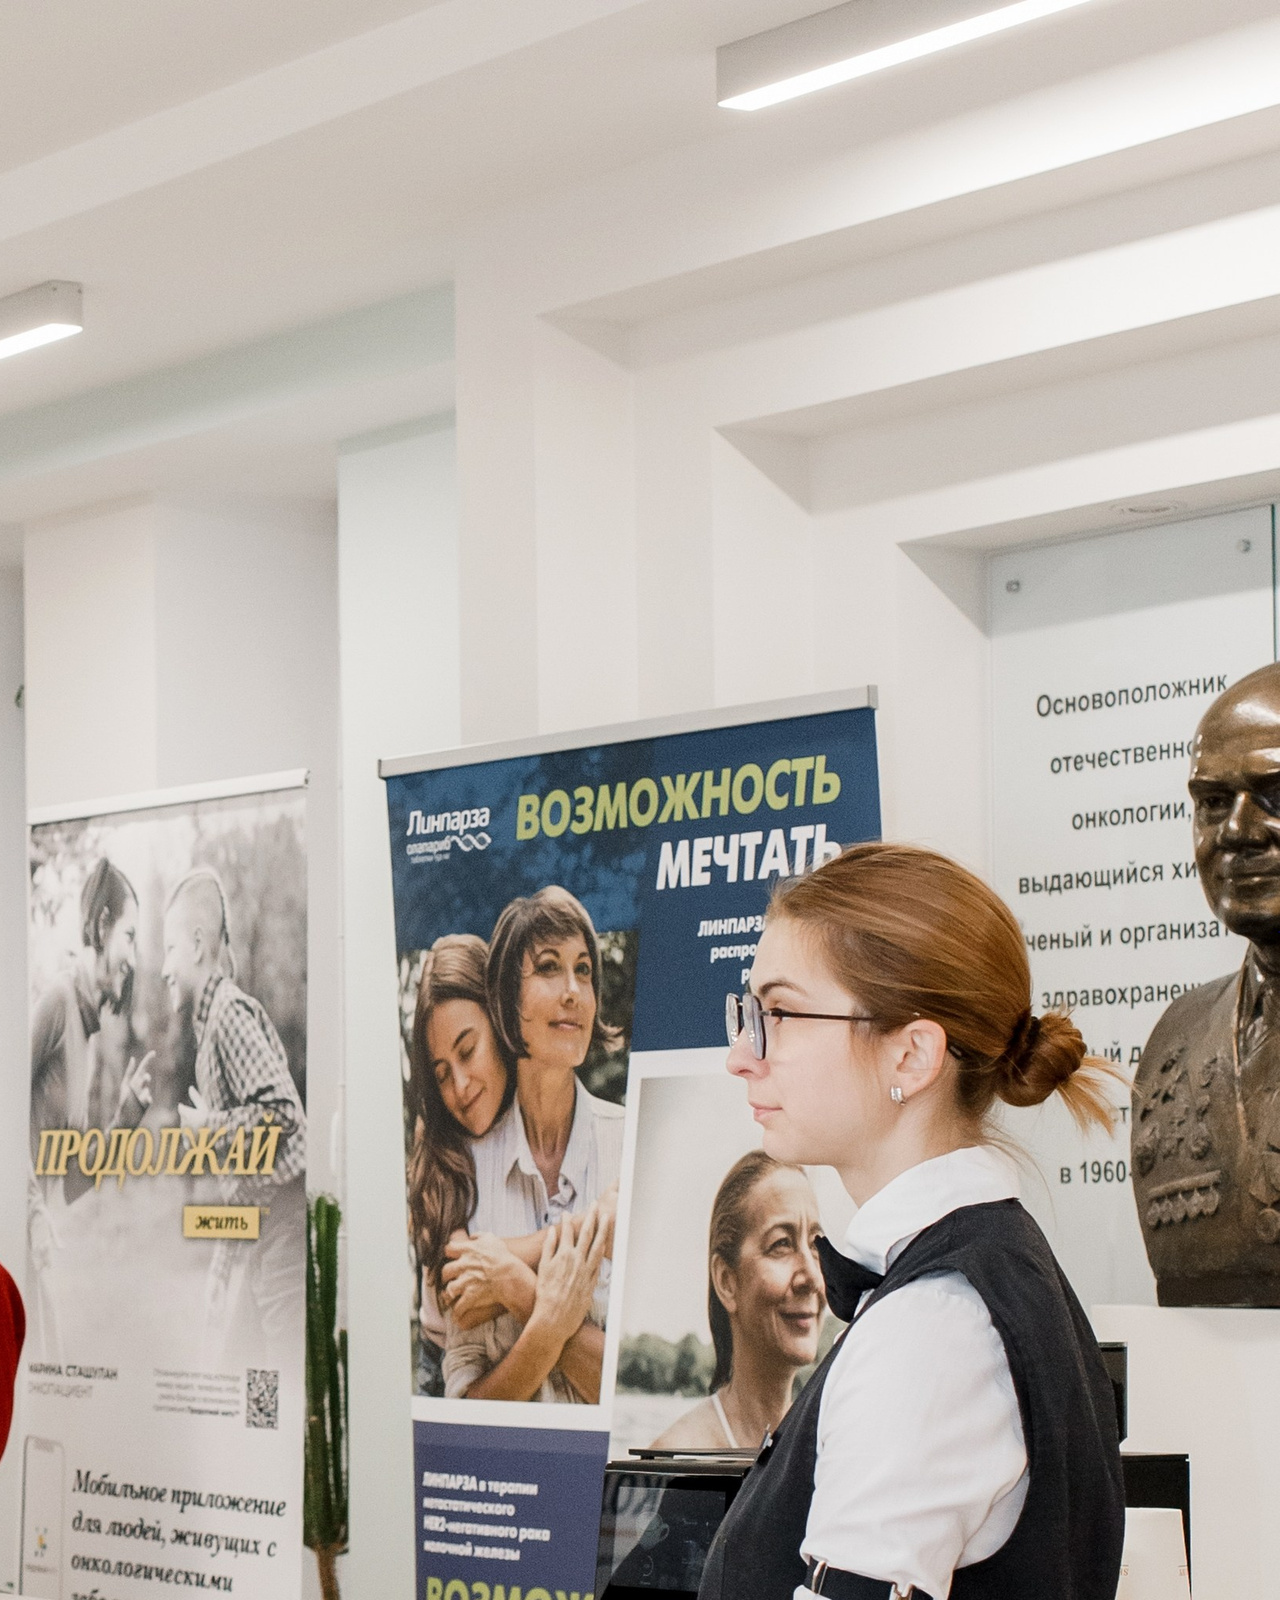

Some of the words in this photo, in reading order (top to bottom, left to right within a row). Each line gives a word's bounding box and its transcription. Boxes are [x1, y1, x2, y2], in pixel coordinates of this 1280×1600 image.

[1036, 674, 1228, 718] Основоположник
[516, 755, 841, 841] ВОЗМОЖНОСТЬ
[1072, 801, 1192, 830] онкологии,
[406, 807, 489, 836] Линпарза
[656, 824, 842, 890] МЕЧТАТЬ
[1019, 860, 1164, 895] выдающийся
[1025, 924, 1092, 951] ченый
[1100, 928, 1112, 946] и
[35, 1112, 283, 1191] ПРОДОЛЖАЙ
[1060, 1167, 1071, 1184] в
[195, 1214, 249, 1231] жить
[72, 1469, 167, 1502] Мобильное
[171, 1488, 287, 1517] приложение
[72, 1510, 102, 1534] для
[105, 1518, 166, 1549] людей,
[170, 1528, 261, 1558] живущих
[266, 1541, 278, 1558] с
[71, 1554, 233, 1592] онкологическими
